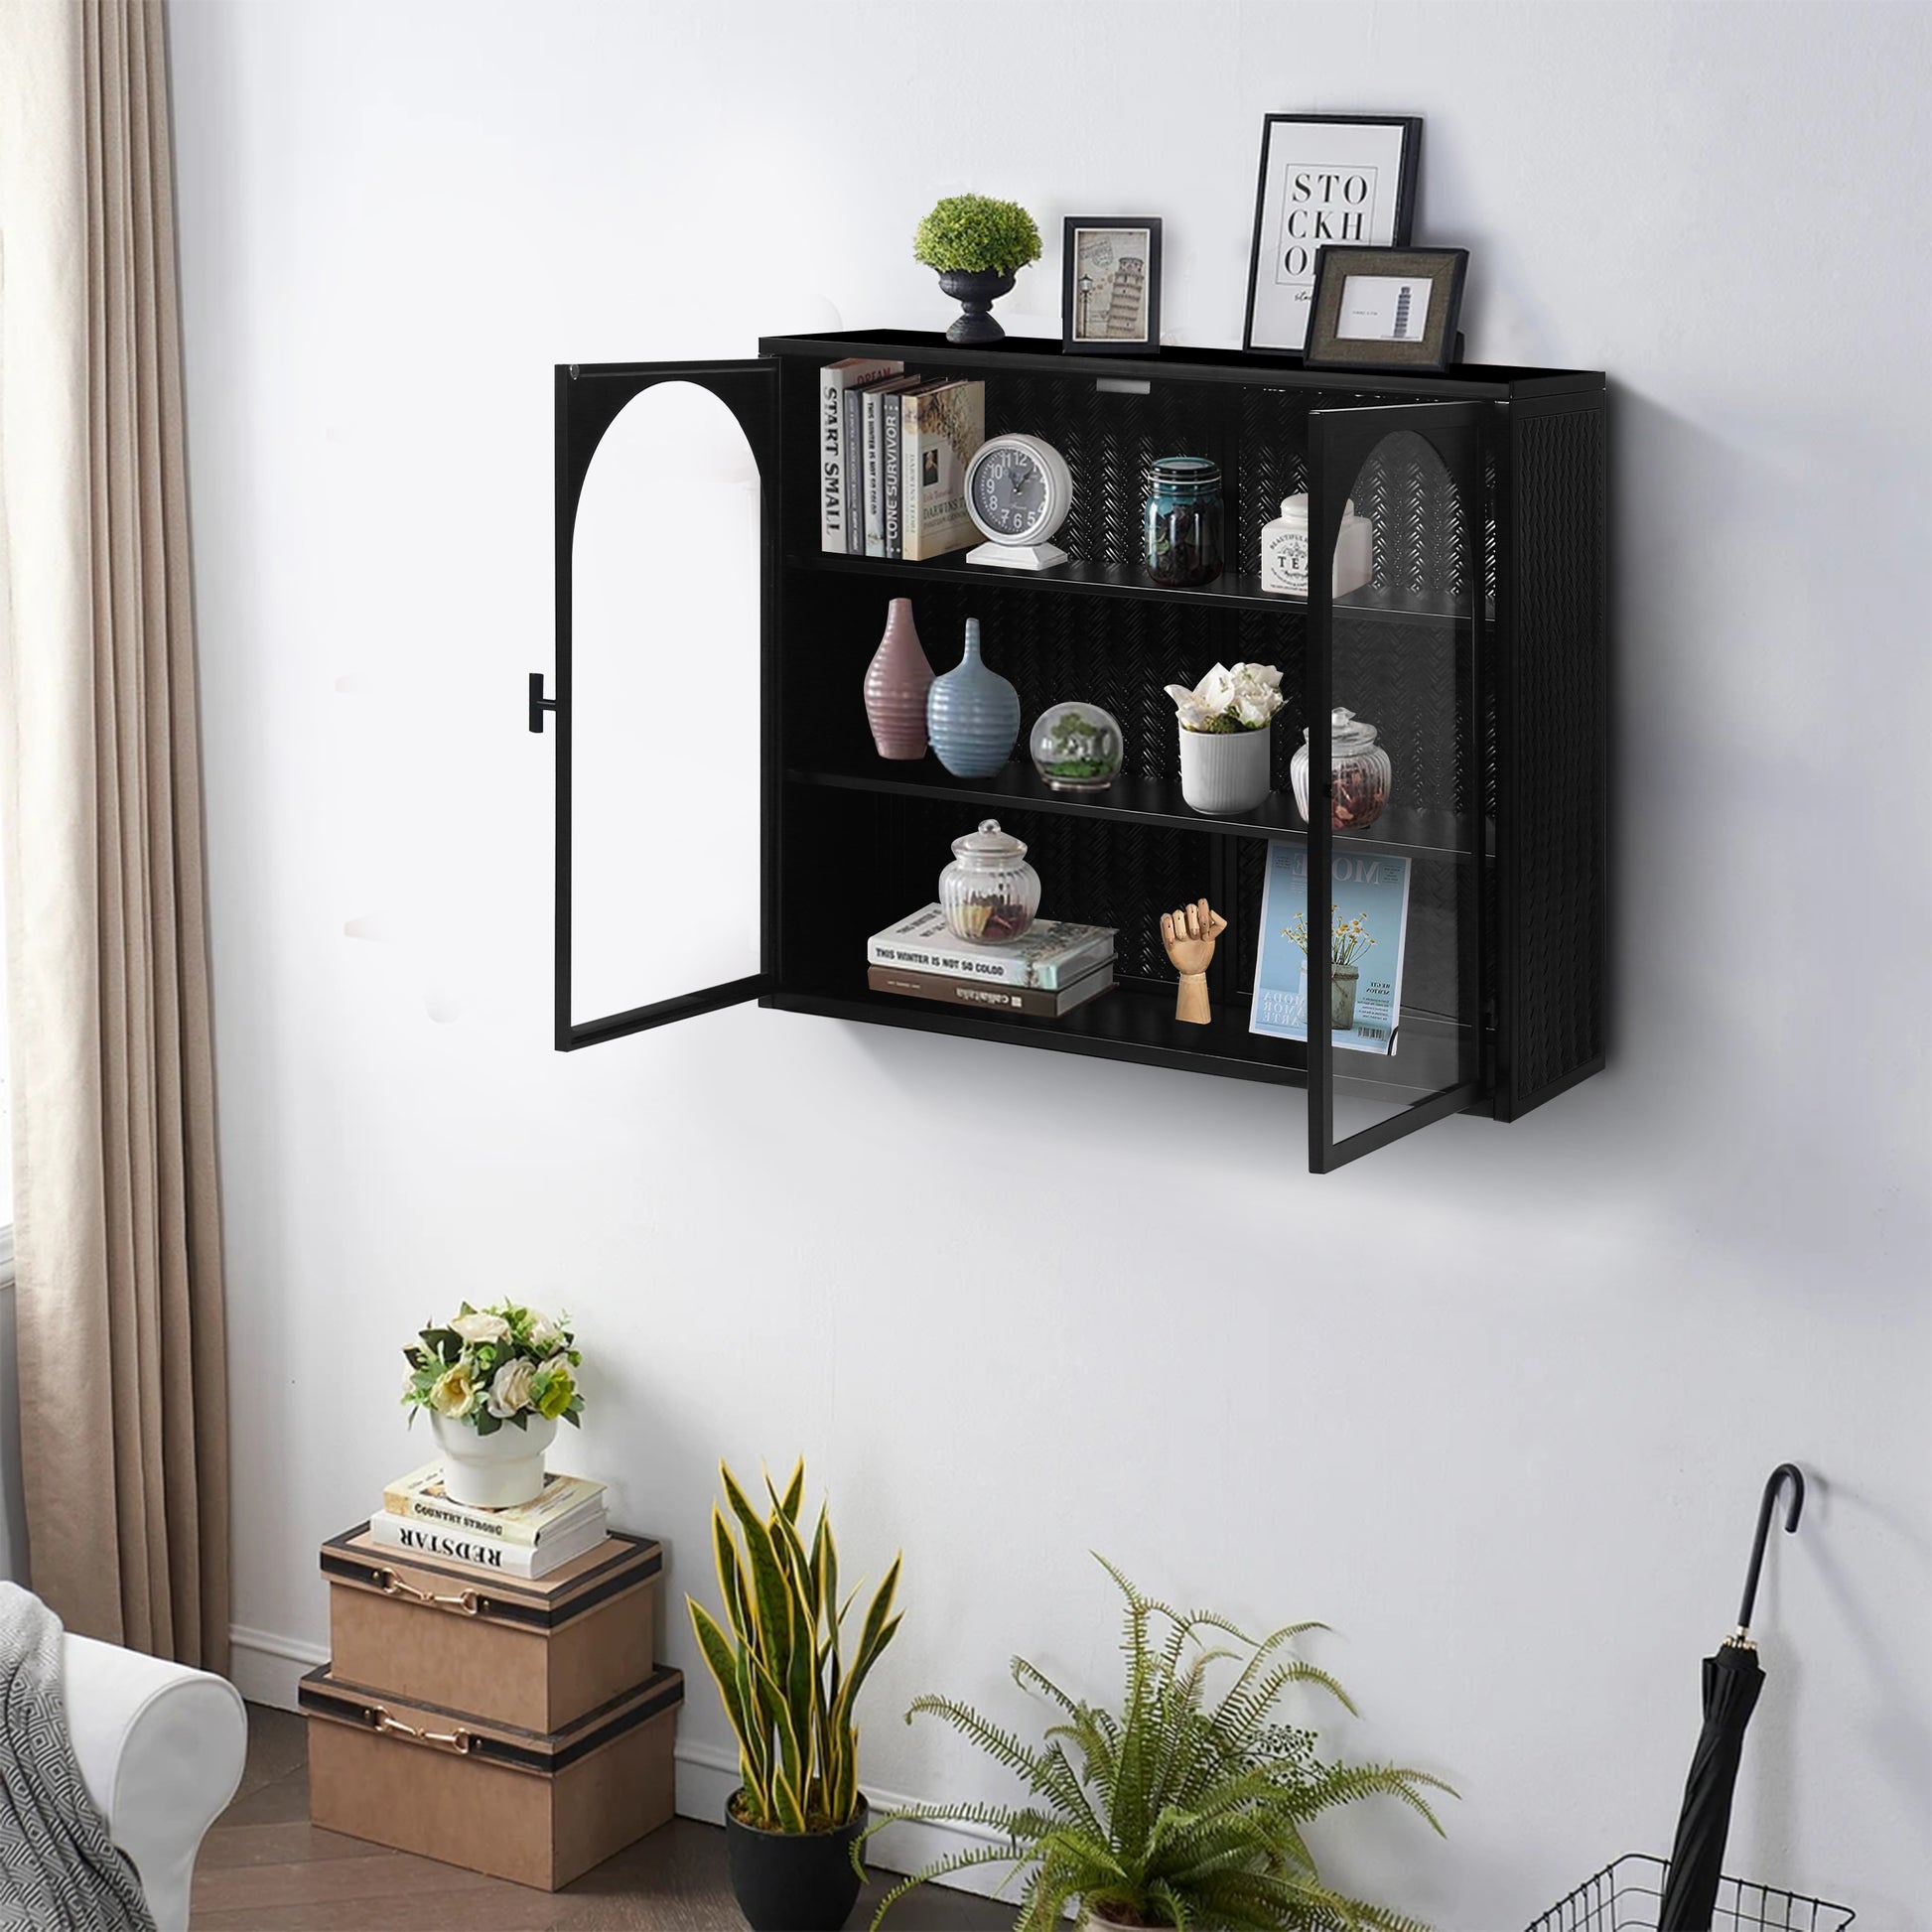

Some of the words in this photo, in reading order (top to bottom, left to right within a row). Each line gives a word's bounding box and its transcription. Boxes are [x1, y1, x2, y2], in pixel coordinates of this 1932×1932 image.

[1293, 173, 1368, 205] STO
[1288, 208, 1364, 241] CKH
[823, 386, 839, 457] START
[886, 415, 897, 497] SURVIVOR
[1001, 453, 1011, 468] 11
[1013, 451, 1028, 467] 12
[988, 464, 1003, 480] 10
[824, 461, 841, 536] SMALL
[986, 479, 995, 494] 9
[989, 495, 998, 510] 8
[887, 497, 898, 540] LONE
[1001, 508, 1010, 523] 7
[1013, 512, 1023, 528] 6
[1027, 511, 1035, 526] 5
[875, 947, 896, 960] THIS
[897, 950, 929, 965] WINTER
[931, 956, 940, 967] IS
[942, 958, 960, 970] NOT
[961, 960, 973, 972] SO
[414, 1502, 462, 1524] COUNTRY
[463, 1517, 503, 1536] STRONG
[399, 1527, 502, 1568] REDSTAR
